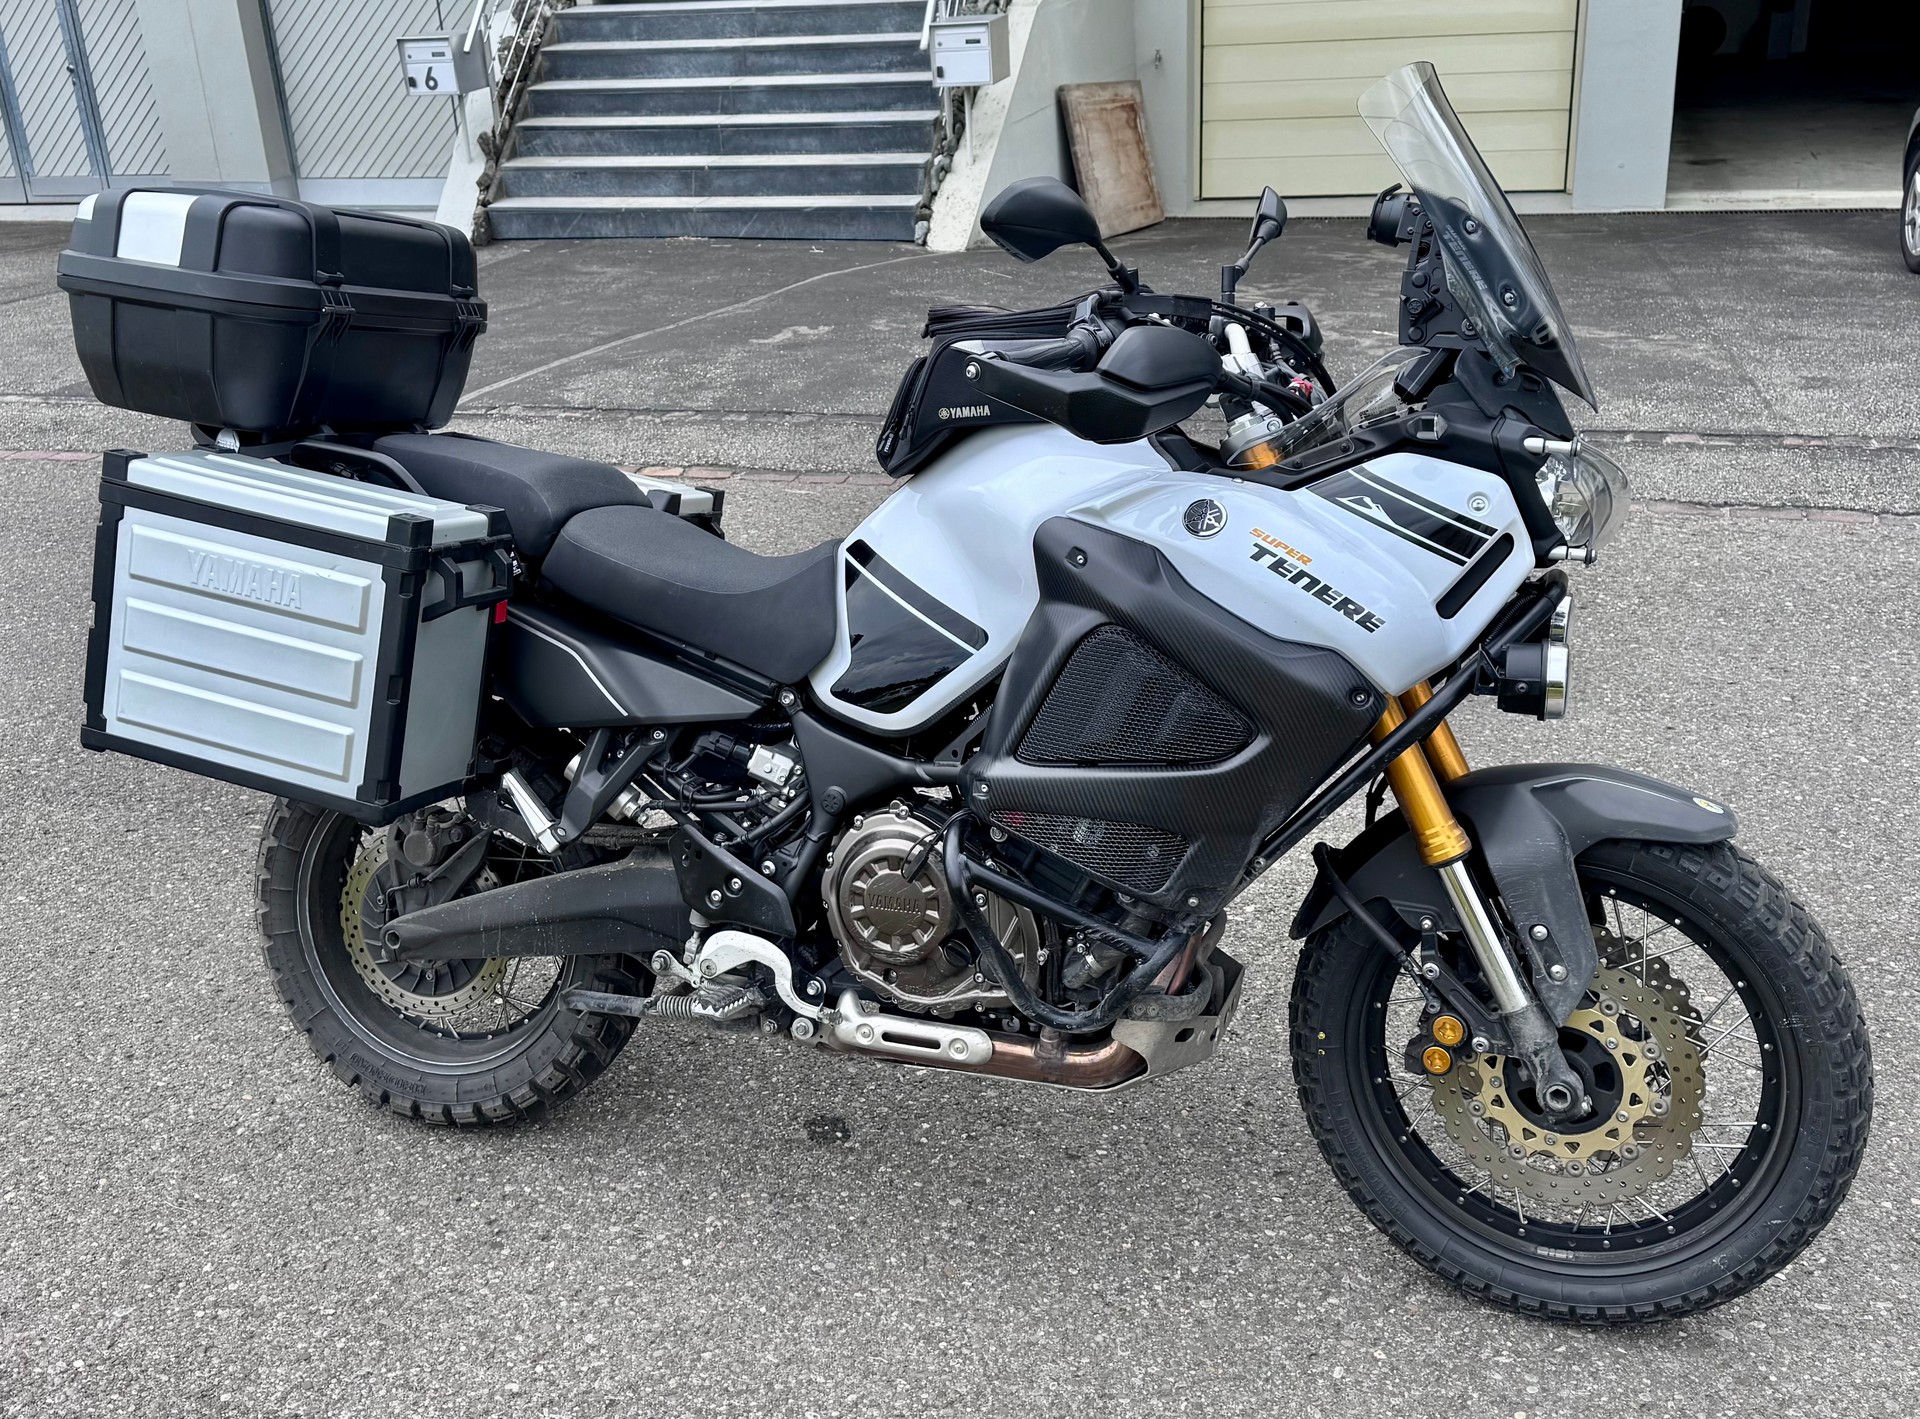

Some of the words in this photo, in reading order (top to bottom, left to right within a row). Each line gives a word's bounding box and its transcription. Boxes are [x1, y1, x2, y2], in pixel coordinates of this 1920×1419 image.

[425, 66, 438, 91] 6
[949, 404, 991, 419] YAMAHA
[1249, 527, 1313, 566] SUPER
[187, 549, 302, 610] YAMAHA
[867, 893, 922, 916] YAMAHA
